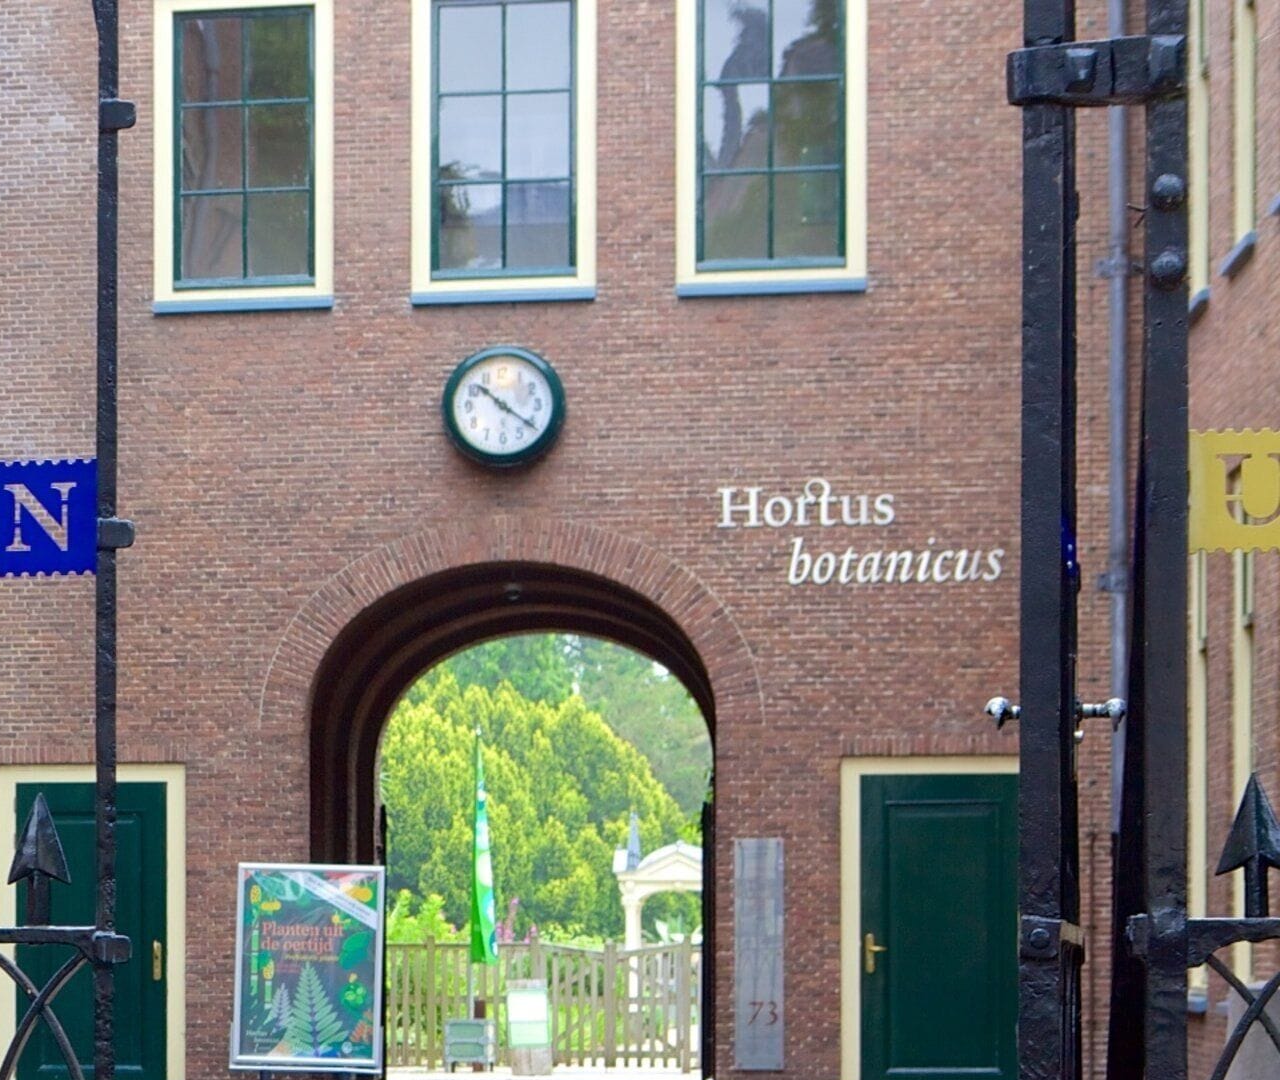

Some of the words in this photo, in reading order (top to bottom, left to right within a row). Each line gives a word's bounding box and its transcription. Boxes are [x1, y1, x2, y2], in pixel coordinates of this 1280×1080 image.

[717, 478, 896, 528] Hortus
[788, 537, 1004, 586] botanicus
[747, 1001, 778, 1026] 73
